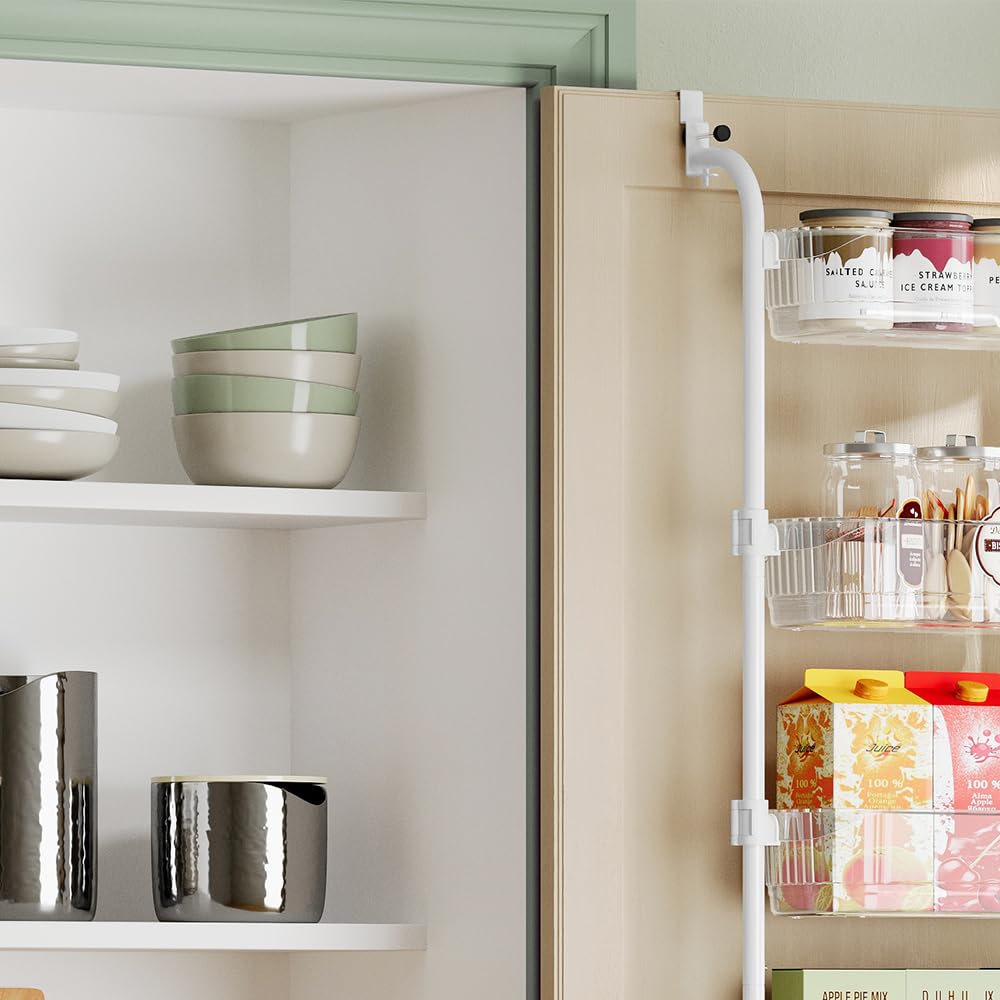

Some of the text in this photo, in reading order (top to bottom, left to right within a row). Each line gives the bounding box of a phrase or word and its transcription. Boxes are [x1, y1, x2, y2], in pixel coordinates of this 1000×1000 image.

[901, 283, 916, 291] ICE
[920, 283, 954, 292] CREAM
[794, 744, 815, 753] Juice
[865, 743, 901, 752] Juice
[868, 777, 904, 788] 100 %
[967, 780, 988, 789] 100
